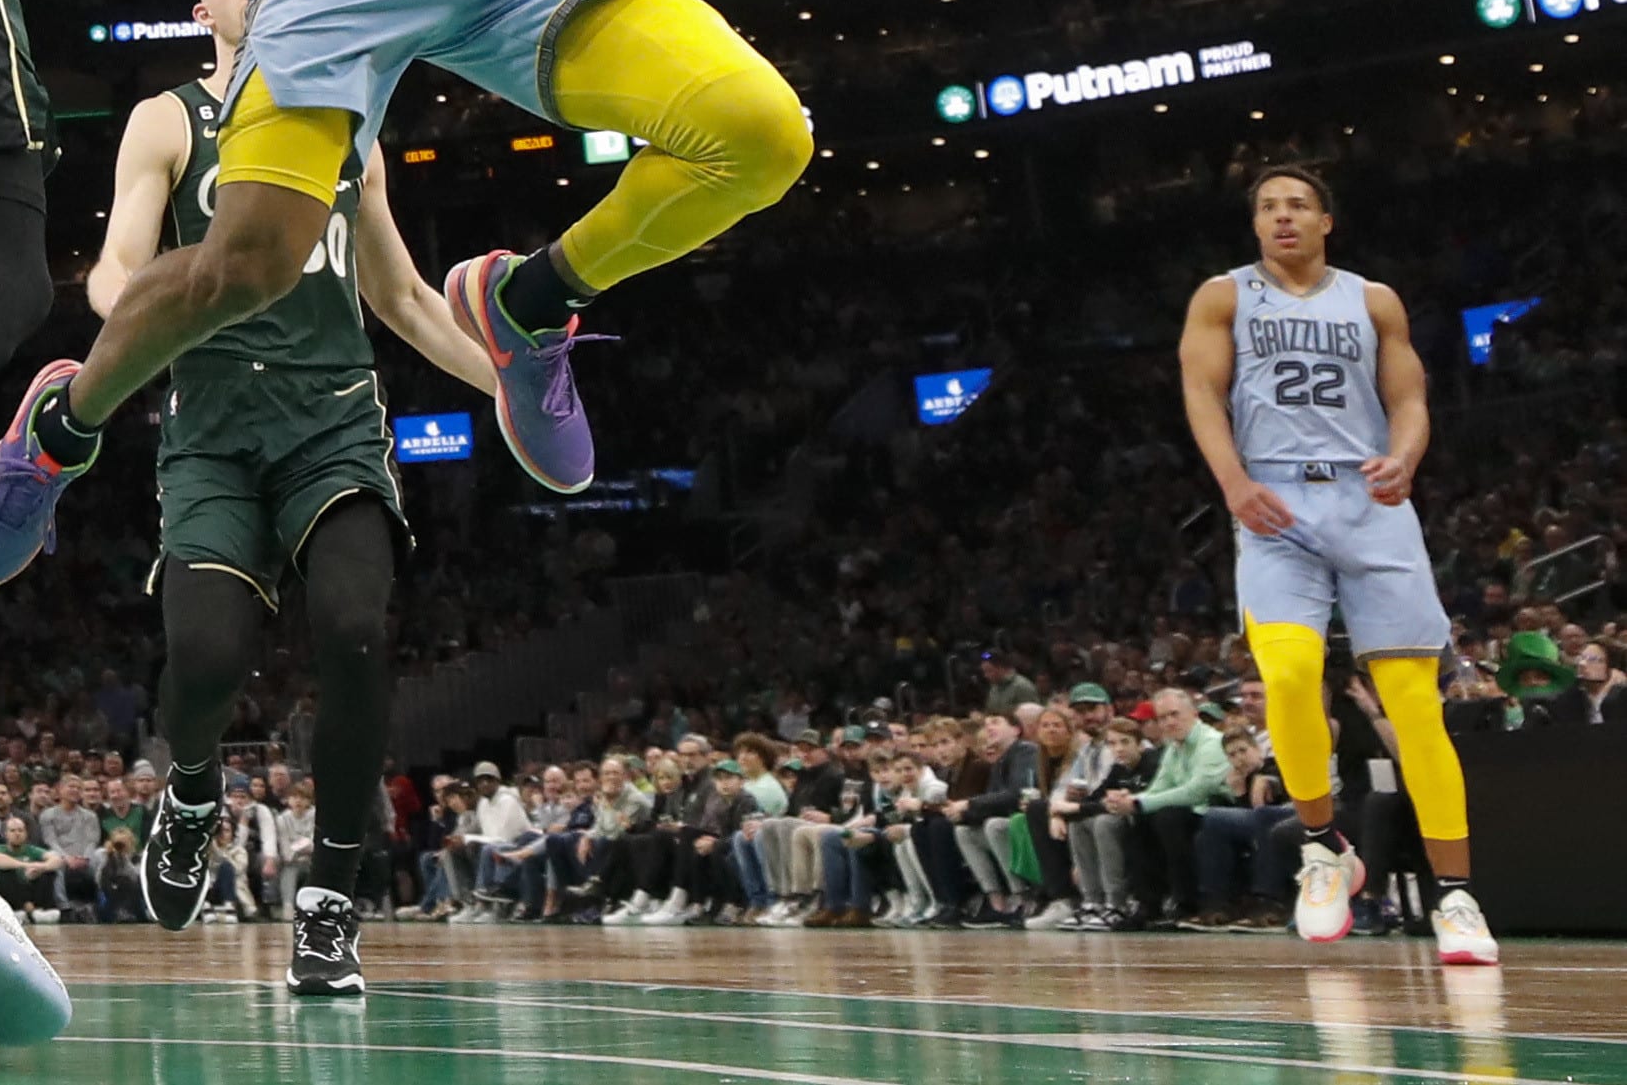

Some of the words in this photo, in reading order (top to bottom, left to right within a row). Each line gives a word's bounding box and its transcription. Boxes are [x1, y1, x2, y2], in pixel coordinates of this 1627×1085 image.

[1024, 51, 1194, 110] Putnam
[1199, 41, 1254, 65] PROUD
[1201, 52, 1271, 78] PARTNER
[199, 105, 214, 120] 6
[1249, 318, 1361, 362] GRIZZLIES
[1274, 360, 1346, 409] 22
[401, 434, 468, 449] ARBELLA
